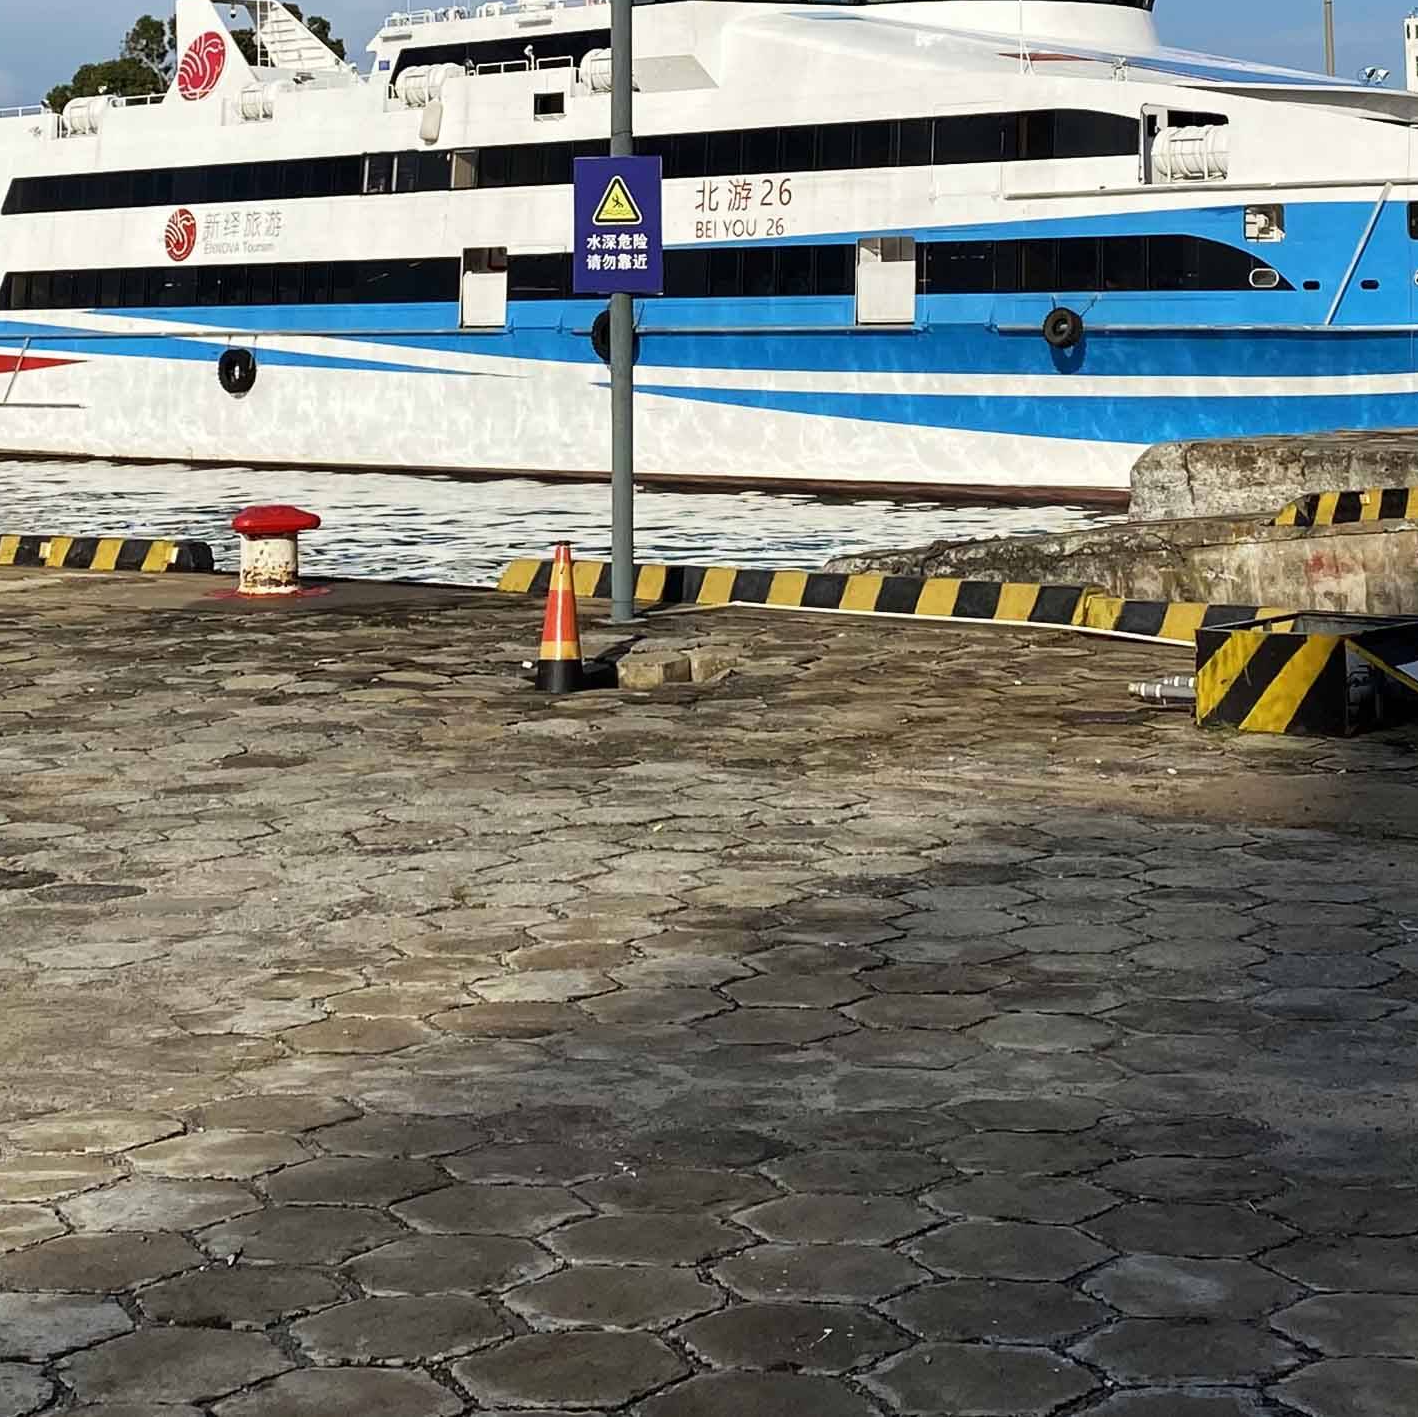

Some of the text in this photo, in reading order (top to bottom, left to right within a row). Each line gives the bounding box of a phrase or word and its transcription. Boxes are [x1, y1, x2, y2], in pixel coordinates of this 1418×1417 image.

[695, 217, 784, 238] BEI YOU 26
[586, 233, 648, 250] 水深危险
[586, 253, 648, 270] 请勿靠近
